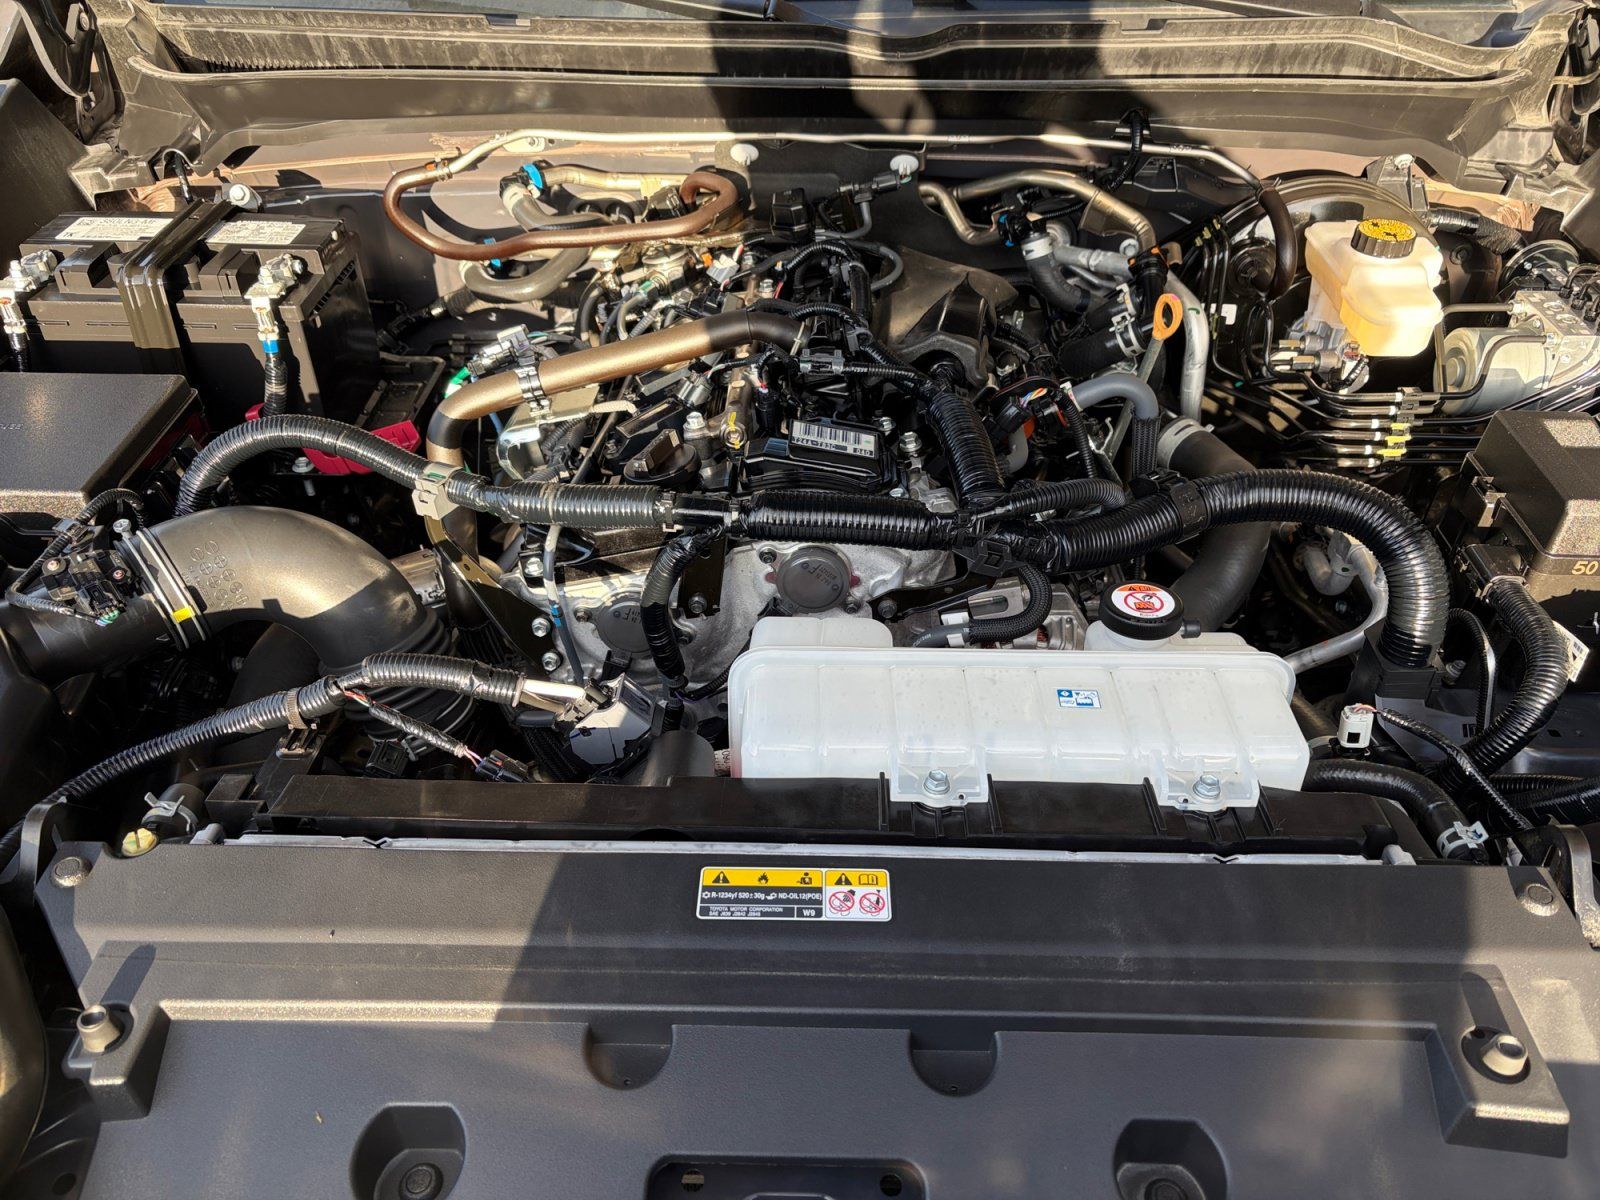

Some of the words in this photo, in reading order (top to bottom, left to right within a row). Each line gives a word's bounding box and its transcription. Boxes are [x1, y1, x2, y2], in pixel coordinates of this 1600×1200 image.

[1571, 560, 1599, 575] 50
[711, 891, 738, 900] R-1234yf
[802, 908, 816, 917] W9
